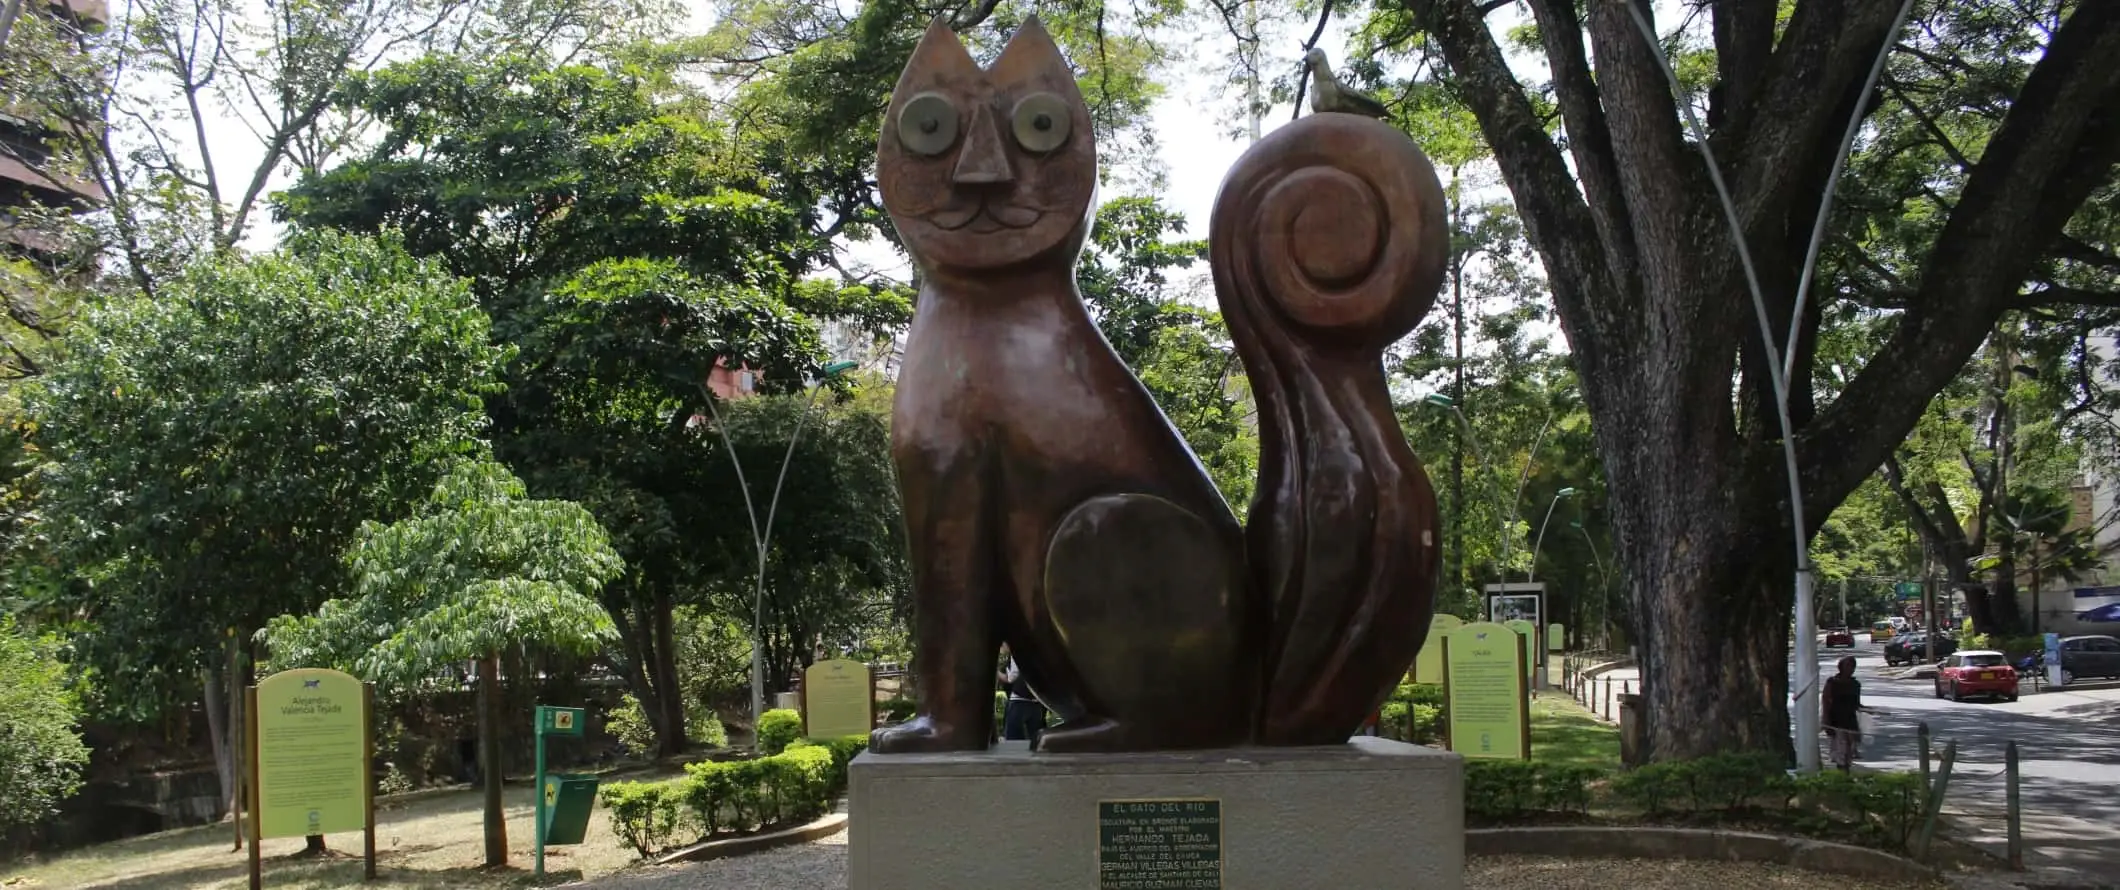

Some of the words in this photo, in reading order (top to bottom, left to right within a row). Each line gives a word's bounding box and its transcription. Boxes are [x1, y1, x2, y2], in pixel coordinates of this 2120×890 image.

[292, 695, 331, 705] Alejandro
[281, 705, 314, 715] Valencia
[1113, 804, 1126, 813] EL
[1130, 803, 1156, 813] GATO
[1161, 803, 1180, 812] DEL
[1140, 818, 1149, 826] EN
[1112, 833, 1165, 843] HERNANDO
[1172, 833, 1210, 842] TEJADA
[1140, 861, 1180, 870] VILLEGAS
[1182, 860, 1219, 870] VILLEGAS
[1185, 880, 1219, 889] CUEVAS
